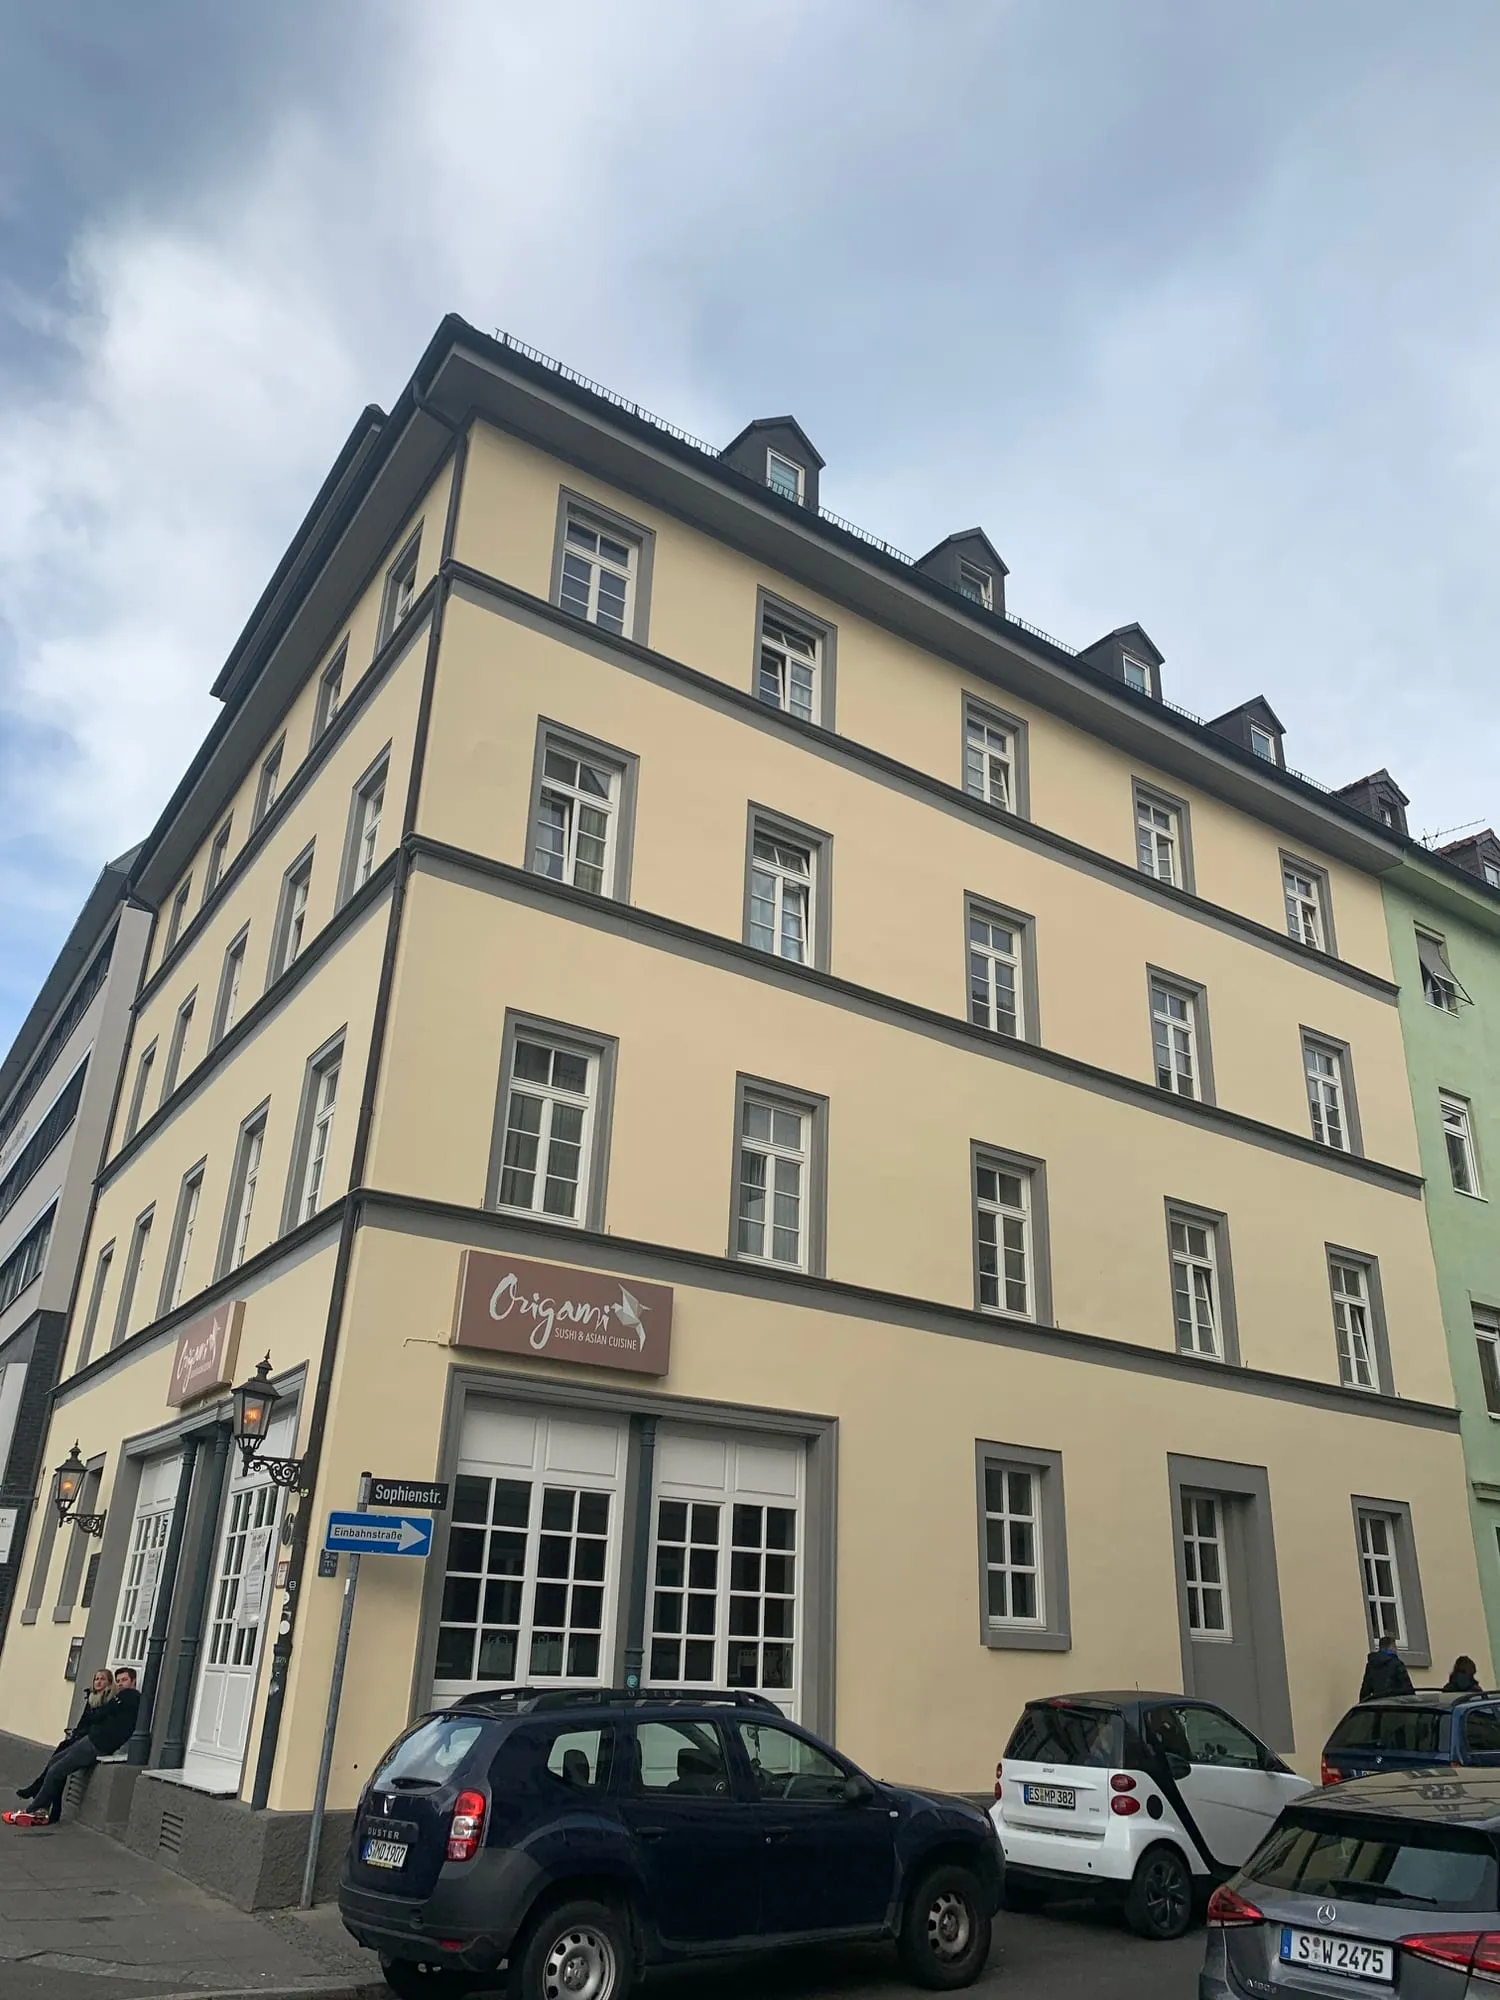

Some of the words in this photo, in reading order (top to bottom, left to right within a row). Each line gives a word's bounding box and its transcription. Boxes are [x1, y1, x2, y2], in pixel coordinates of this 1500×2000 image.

[489, 1272, 610, 1350] Origami
[554, 1327, 577, 1341] SUSHI
[577, 1331, 584, 1342] &
[584, 1332, 607, 1345] ASIAN
[608, 1335, 637, 1351] CUISINE
[375, 1484, 442, 1504] Sophienstr.
[334, 1527, 403, 1540] Einbahnstraße
[1029, 1787, 1040, 1801] ES
[1057, 1791, 1073, 1805] 382
[367, 1826, 400, 1840] DUSTER
[1298, 1935, 1310, 1959] S
[1322, 1940, 1334, 1965] W
[1337, 1943, 1384, 1974] 2475
